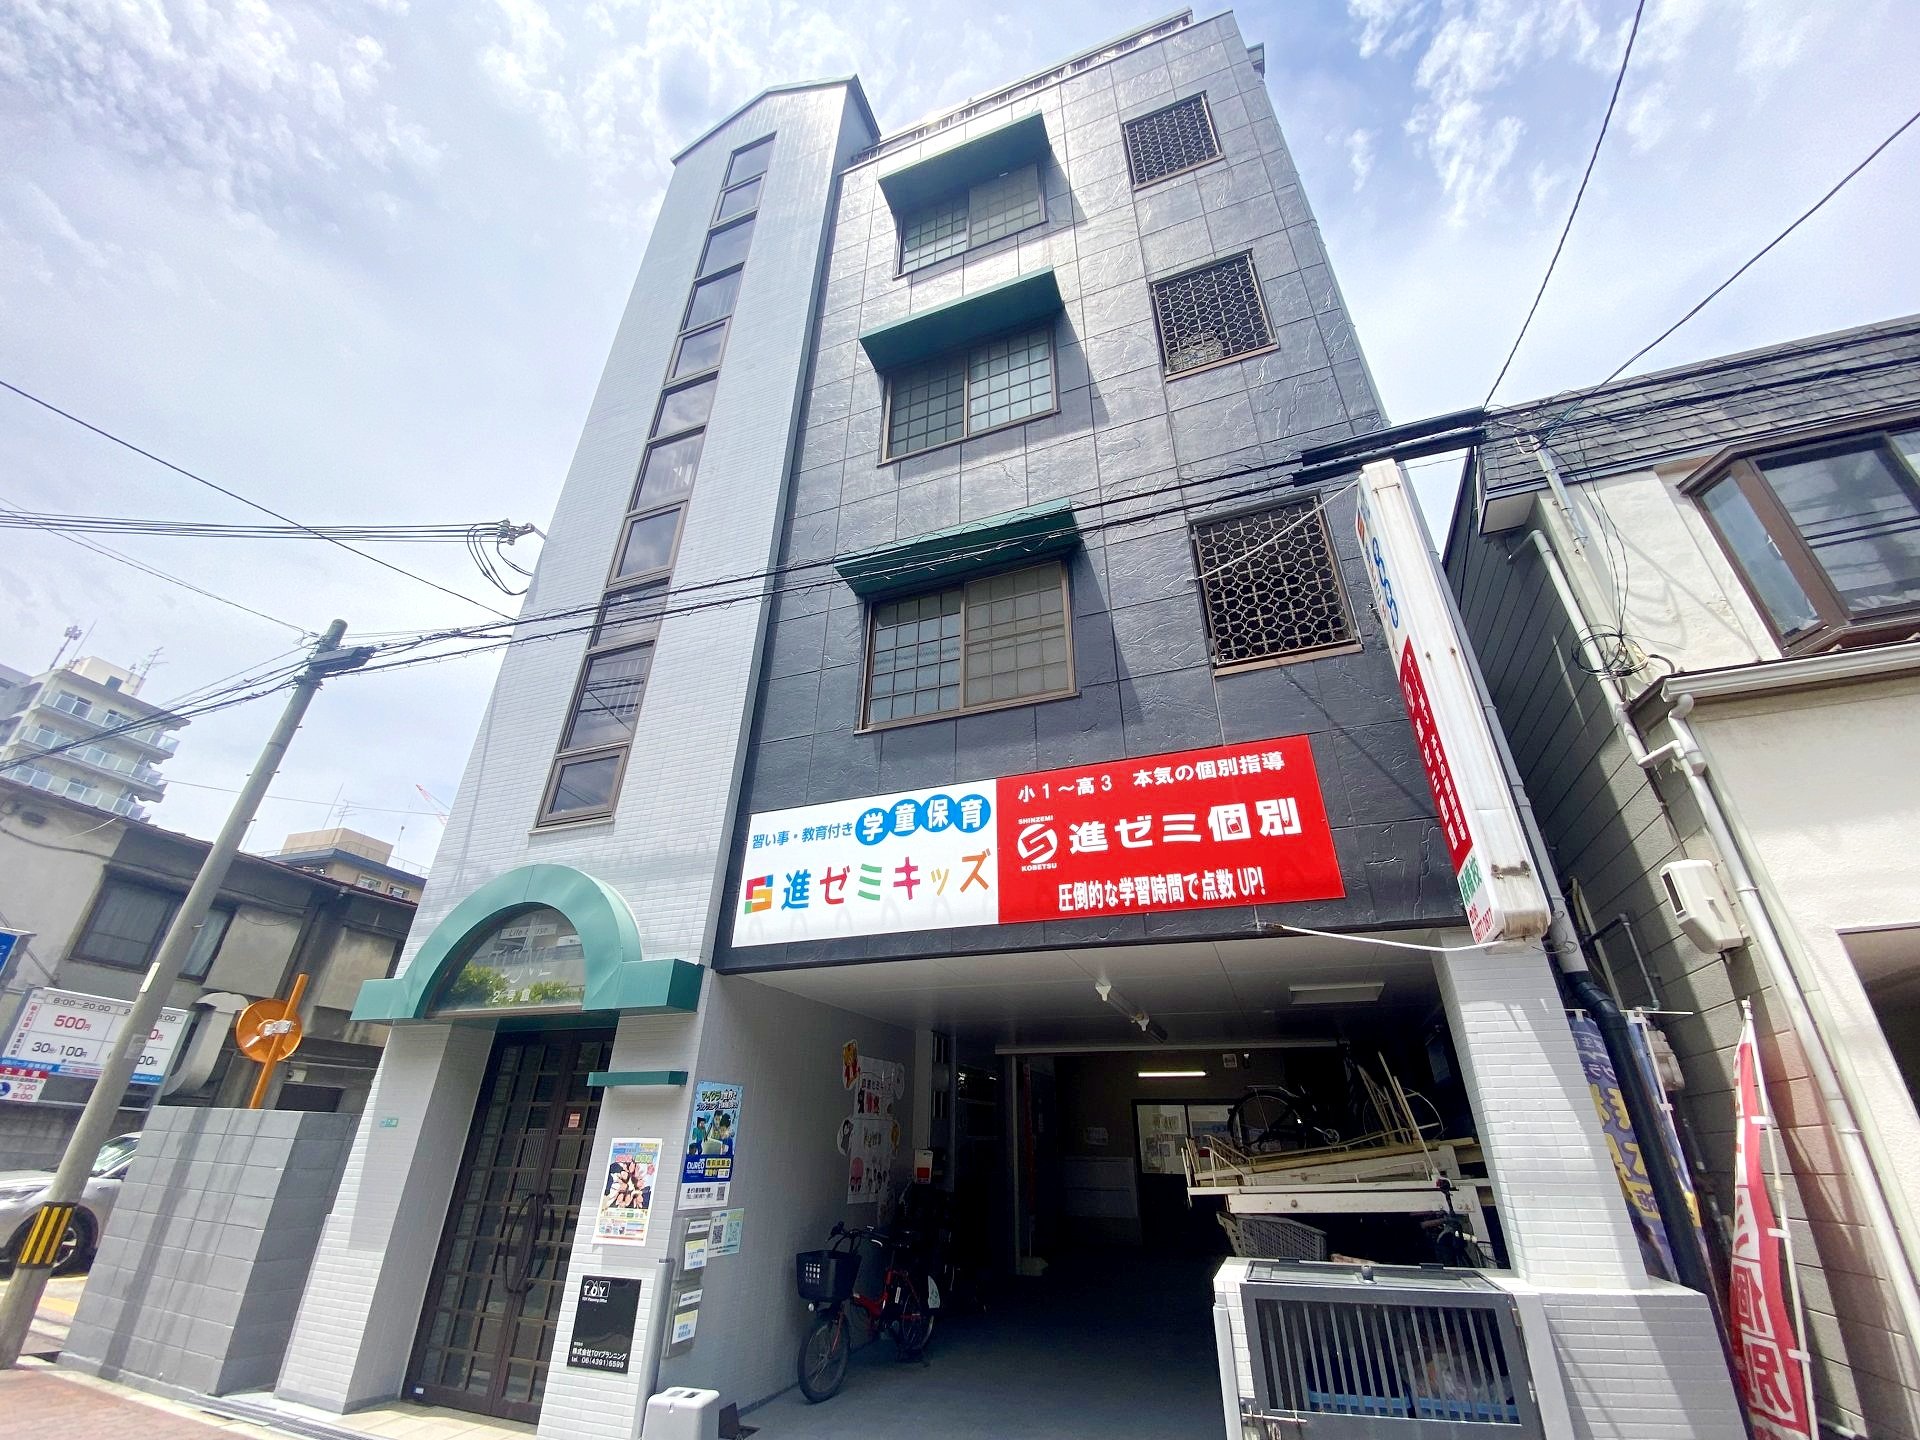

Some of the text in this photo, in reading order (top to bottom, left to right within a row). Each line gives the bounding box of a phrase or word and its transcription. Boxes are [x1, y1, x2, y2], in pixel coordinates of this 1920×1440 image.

[1132, 751, 1286, 788] 本気の個別指導
[752, 798, 983, 849] 習い事・教育付き 学童保育
[1018, 815, 1054, 825] SHINZEMI
[1068, 797, 1303, 855] 進ゼミ個別
[780, 848, 992, 912] 進ゼミキッズ
[1021, 862, 1058, 872] KOBETSU
[583, 1285, 606, 1297] TOY
